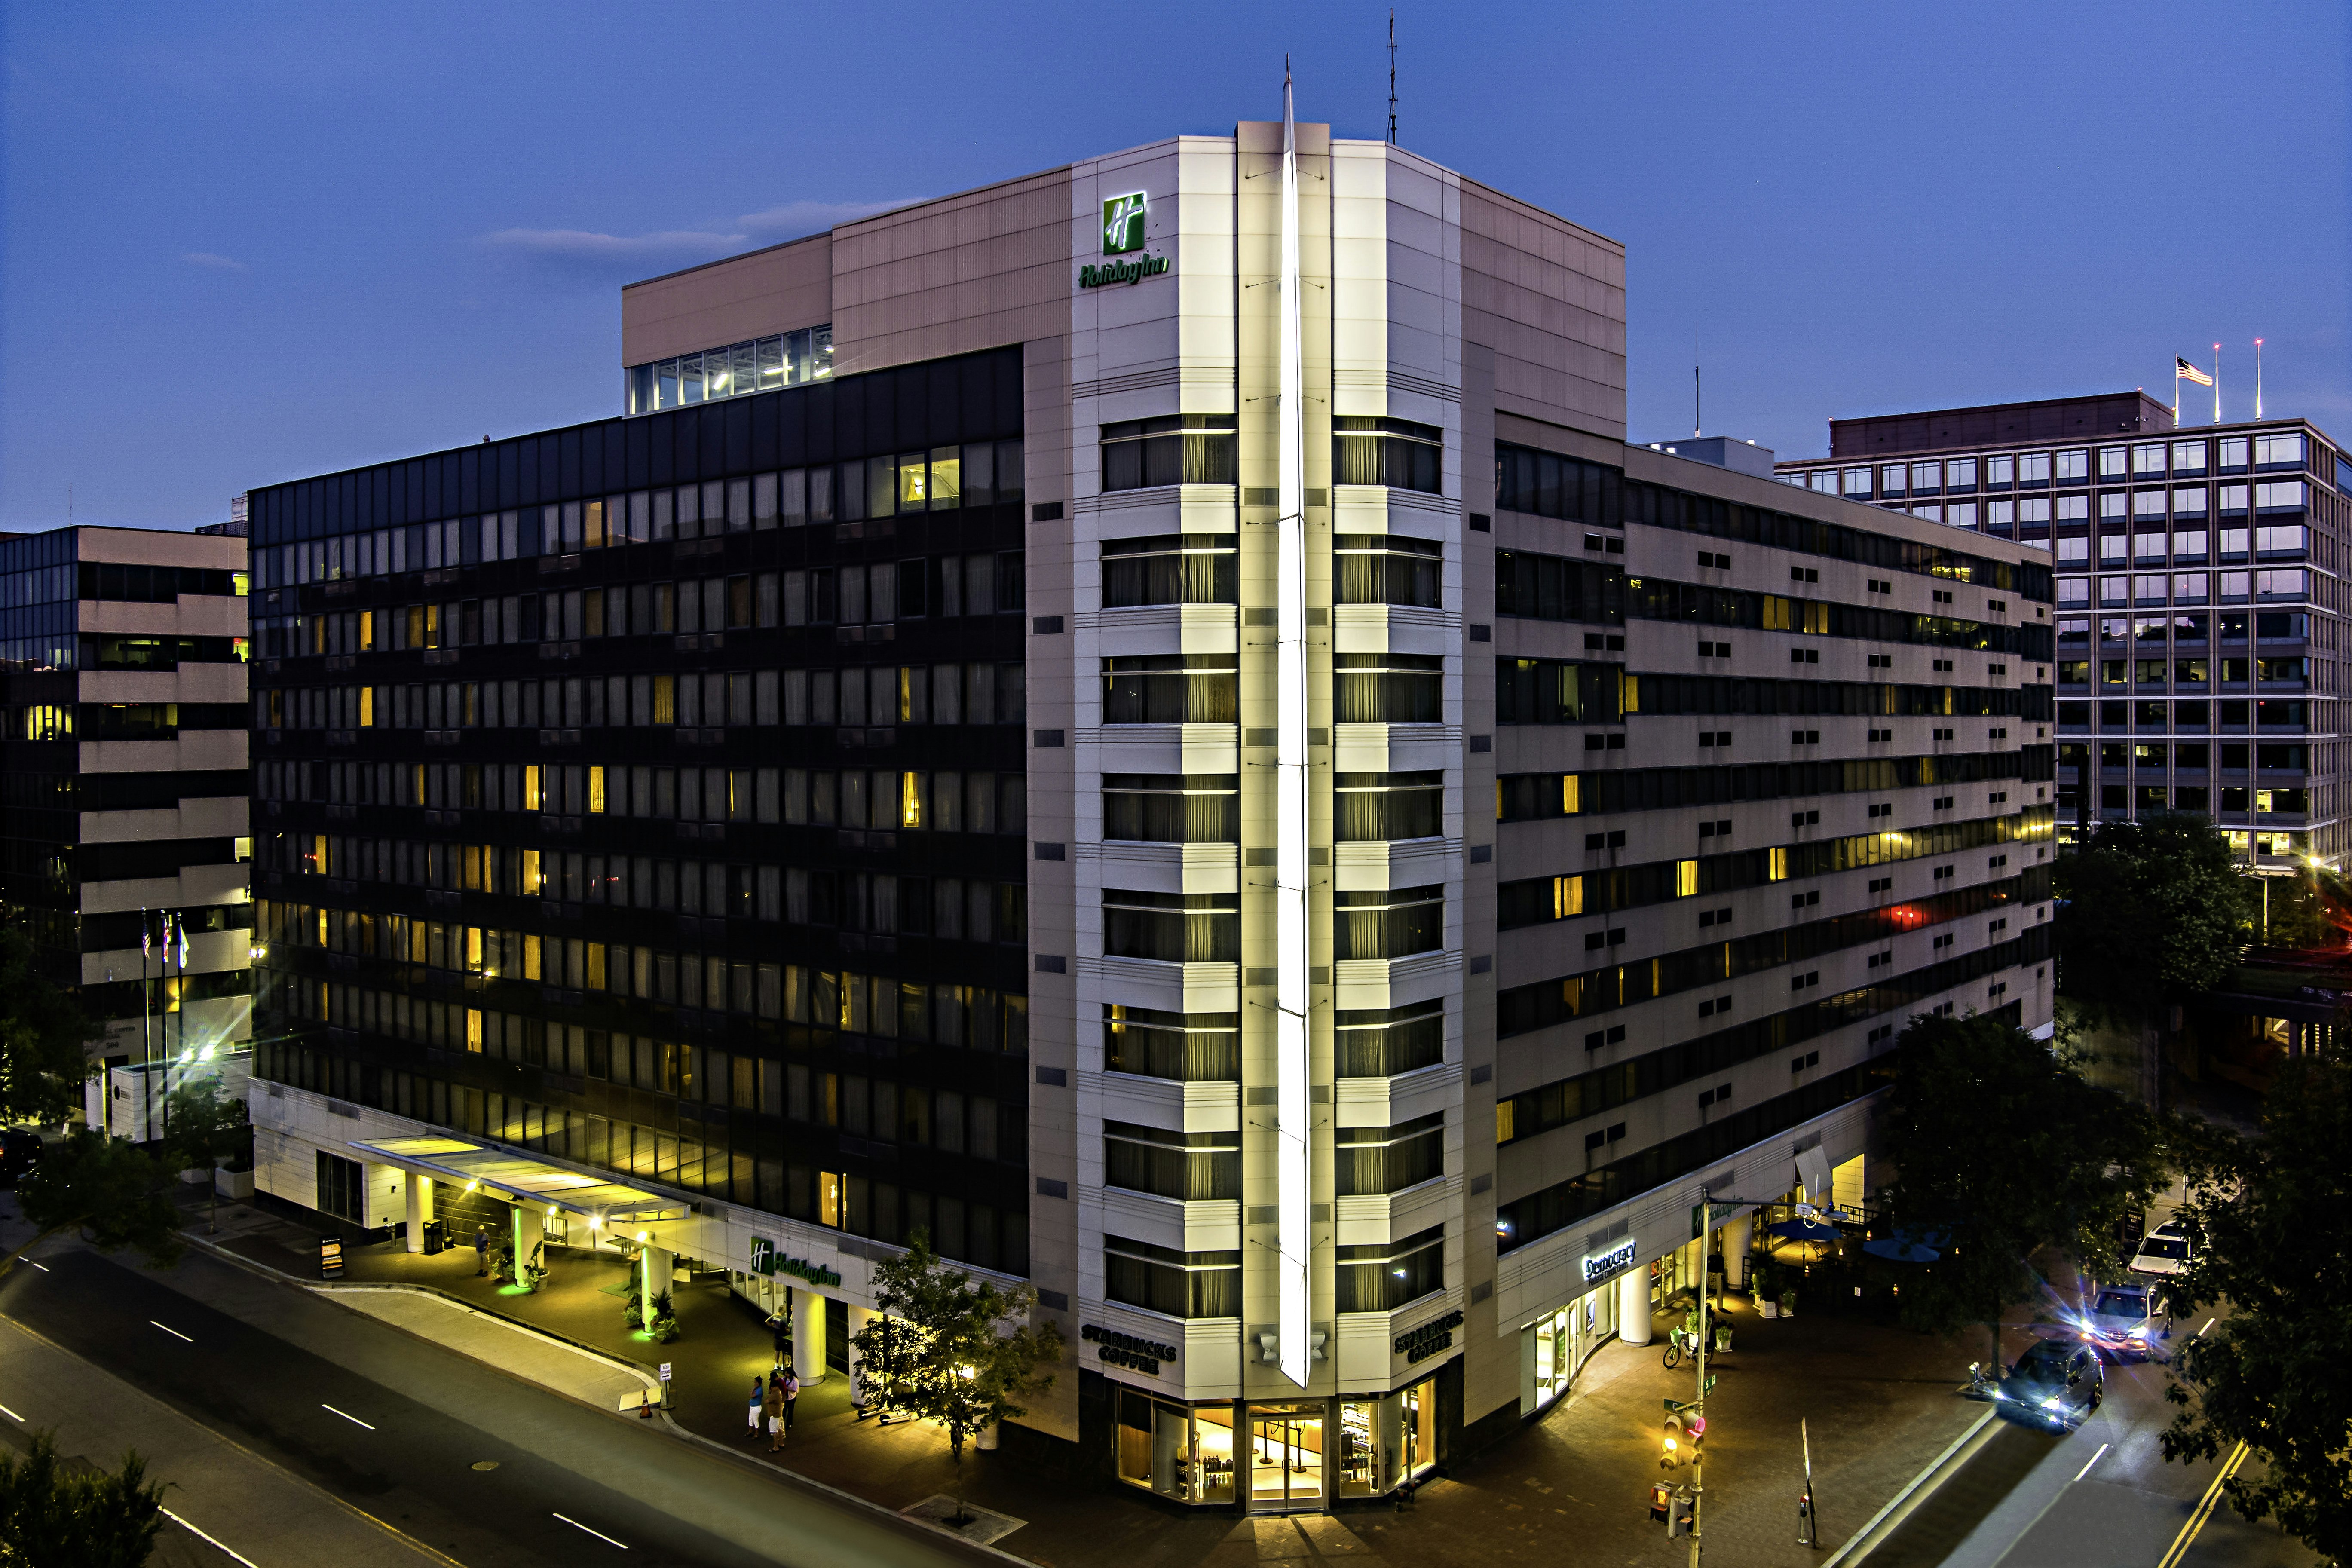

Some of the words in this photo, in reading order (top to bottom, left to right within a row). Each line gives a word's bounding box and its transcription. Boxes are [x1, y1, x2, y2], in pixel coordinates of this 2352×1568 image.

[1078, 259, 1141, 288] Holiday
[1141, 253, 1169, 276] Inn
[774, 1252, 820, 1285] Holiday
[819, 1264, 841, 1286] Inn
[1586, 1242, 1636, 1278] Democracy
[1589, 1273, 1604, 1286] Federal
[1605, 1265, 1617, 1278] Credit
[1081, 1324, 1176, 1362] STARBUCKS
[1395, 1310, 1464, 1354] STARBUCKS
[1407, 1332, 1452, 1363] COFFEE
[1099, 1346, 1159, 1375] COFFEE
[1706, 1380, 1709, 1389] 6
